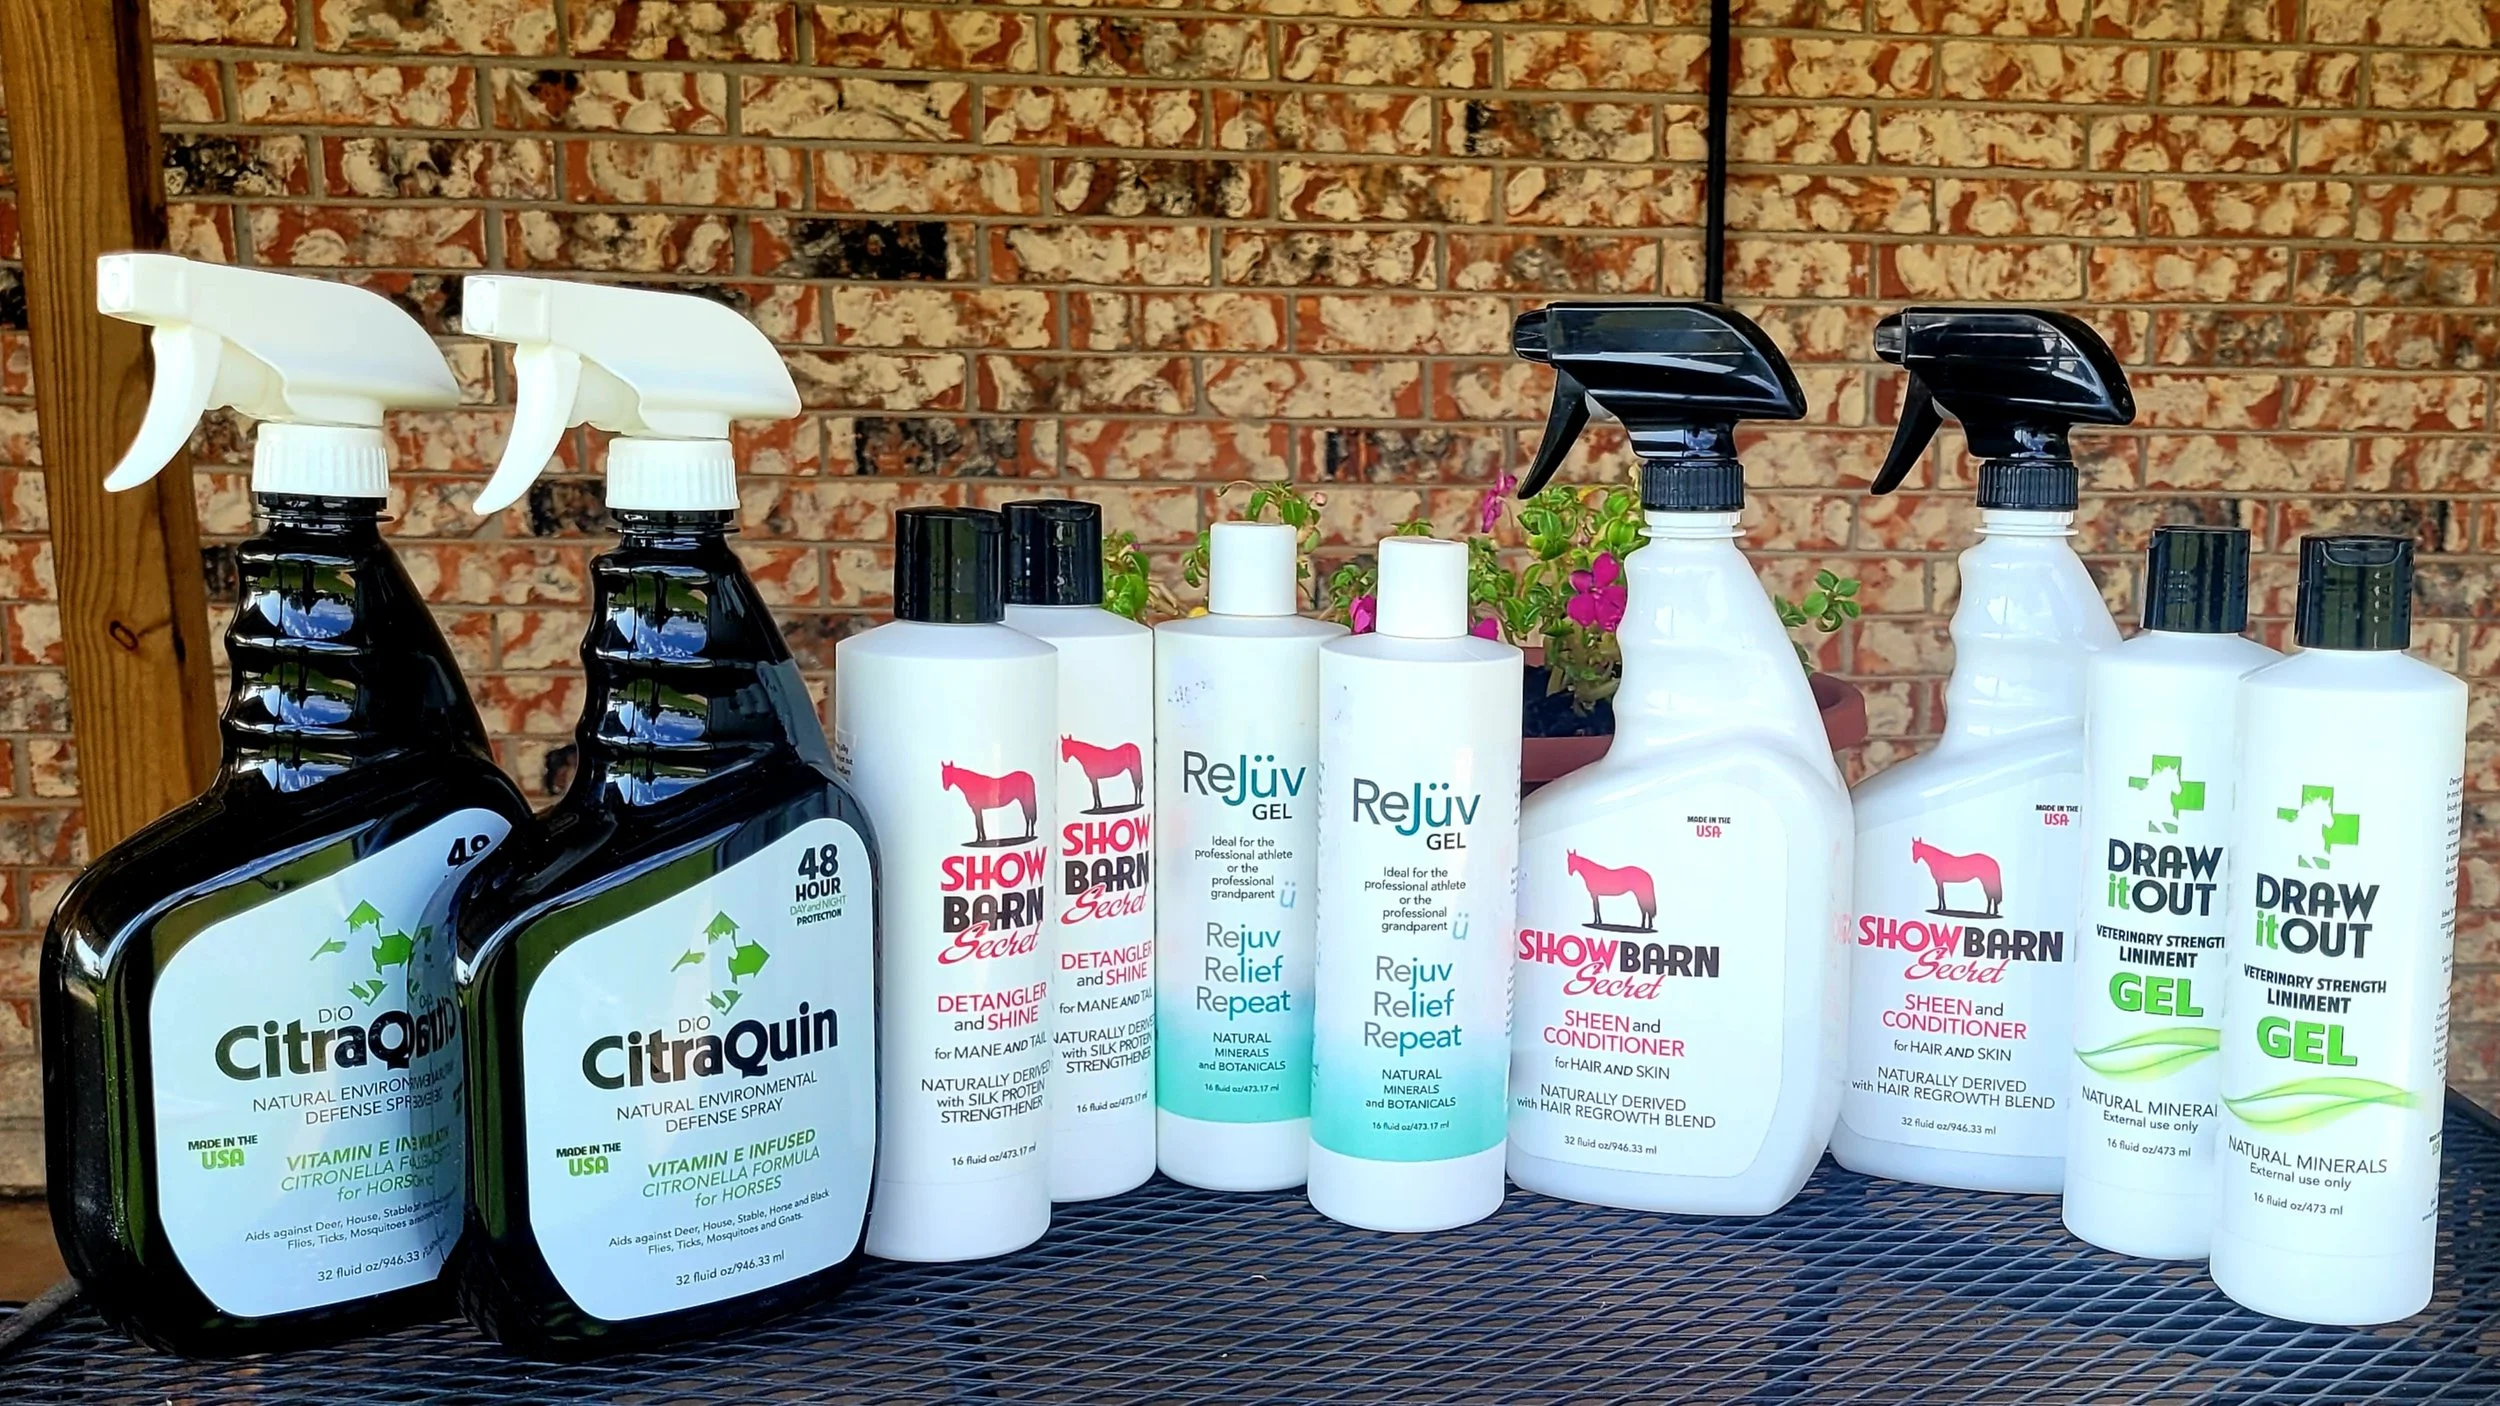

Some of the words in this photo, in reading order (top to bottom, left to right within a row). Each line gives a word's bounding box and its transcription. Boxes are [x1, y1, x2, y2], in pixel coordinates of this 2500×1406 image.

[1184, 751, 1306, 806] ReJüv
[1253, 803, 1292, 820] GEL
[1353, 778, 1481, 836] ReJüv
[2044, 813, 2070, 826] USA
[1062, 814, 1150, 856] SHOW
[1426, 833, 1466, 850] GEL
[1697, 825, 1722, 838] USA
[798, 844, 838, 880] 48
[941, 847, 1046, 891] SHOW
[1065, 851, 1148, 895] BARN
[1384, 867, 1410, 877] Ideal
[1412, 867, 1428, 878] for
[1431, 867, 1448, 877] the
[2108, 838, 2224, 882] DRAW
[796, 877, 841, 902] HOUR
[1365, 880, 1428, 891] professional
[1431, 880, 1466, 891] athlete
[1414, 894, 1432, 904] the
[2256, 872, 2380, 922] DRAW
[797, 908, 841, 926] PROTECTION
[944, 886, 1044, 933] BARN
[1061, 883, 1148, 924] Secret
[1383, 907, 1447, 920] professional
[938, 921, 1042, 964] Secret
[1207, 922, 1281, 956] Rejuv
[1382, 921, 1448, 935] grandparent
[2097, 924, 2163, 946] VETERINARY
[1062, 941, 1152, 970] DETANGLER
[1205, 955, 1284, 983] Relief
[1904, 947, 2010, 983] Secret
[2120, 946, 2198, 968] LINIMENT
[1077, 971, 1103, 987] and
[1106, 962, 1147, 985] SHINE
[1376, 956, 1453, 990] Rejuv
[1563, 962, 1665, 999] Secret
[2244, 963, 2314, 989] VETERINARY
[2316, 978, 2387, 993] STRENGTH
[938, 982, 1046, 1012] DETANGLER
[1196, 986, 1291, 1021] Repeat
[1374, 988, 1455, 1018] Relief
[1905, 994, 1972, 1016] SHEEN
[1975, 1003, 2004, 1016] and
[2109, 972, 2204, 1017] GEL
[2267, 988, 2351, 1013] LINIMENT
[319, 1006, 353, 1023] DiO
[679, 1016, 711, 1033] DiO
[955, 1015, 984, 1031] and
[988, 1005, 1038, 1030] SHINE
[1565, 1010, 1629, 1033] SHEEN
[1633, 1019, 1660, 1033] and
[1883, 1011, 2027, 1039] CONDITIONER
[215, 1010, 411, 1081] CitraQ
[582, 1001, 838, 1090] CitraQuin
[935, 1048, 952, 1059] for
[955, 1043, 1001, 1059] MANE
[1003, 1040, 1028, 1054] AND
[1030, 1032, 1047, 1047] TAIL
[1364, 1021, 1462, 1057] Repeat
[1544, 1027, 1685, 1057] CONDITIONER
[2257, 1016, 2358, 1066] GEL
[922, 1073, 1010, 1091] NATURALLY
[1013, 1060, 1051, 1084] DERIVED
[1382, 1069, 1442, 1080] NATURAL
[1555, 1056, 1569, 1069] for
[1571, 1059, 1601, 1073] HAIR
[1604, 1065, 1633, 1076] AND
[1637, 1065, 1670, 1079] SKIN
[253, 1089, 336, 1112] NATURAL
[617, 1099, 694, 1120] NATURAL
[699, 1070, 818, 1108] ENVIRONMENTAL
[937, 1097, 964, 1107] with
[969, 1092, 999, 1106] SILK
[1002, 1078, 1045, 1102] PROTEIN
[1365, 1099, 1385, 1108] and
[1387, 1097, 1456, 1109] BOTANICALS
[1384, 1085, 1440, 1095] MINERALS
[1541, 1084, 1618, 1106] NATURALLY
[1622, 1095, 1686, 1111] DERIVED
[2082, 1086, 2143, 1113] NATURAL
[306, 1105, 382, 1124] DEFENSE
[666, 1110, 737, 1132] DEFENSE
[741, 1098, 783, 1119] SPRAY
[941, 1095, 1043, 1123] STRENGTHENER
[1517, 1097, 1537, 1109] with
[1541, 1099, 1571, 1115] HAIR
[1575, 1106, 1660, 1125] REGROWTH
[1665, 1114, 1716, 1129] BLEND
[2104, 1110, 2146, 1128] External
[2150, 1121, 2170, 1130] use
[2174, 1120, 2199, 1134] only
[1383, 1122, 1400, 1130] fluid
[1401, 1122, 1438, 1131] oz/473.17
[188, 1140, 221, 1150] MADE
[224, 1138, 236, 1147] IN
[237, 1135, 258, 1145] THE
[287, 1144, 372, 1171] VITAMIN
[379, 1141, 389, 1155] E
[556, 1147, 587, 1158] MADE
[589, 1145, 600, 1154] IN
[602, 1142, 621, 1153] THE
[648, 1150, 728, 1178] VITAMIN
[734, 1147, 744, 1162] E
[749, 1129, 816, 1160] INFUSED
[1564, 1136, 1575, 1145] 32
[1577, 1137, 1595, 1148] fluid
[1598, 1140, 1643, 1153] oz/946.33
[1646, 1146, 1657, 1155] ml
[2229, 1134, 2292, 1166] NATURAL
[2297, 1155, 2387, 1173] MINERALS
[202, 1149, 244, 1170] USA
[569, 1156, 609, 1176] USA
[642, 1166, 748, 1198] CITRONELLA
[752, 1146, 820, 1176] FORMULA
[281, 1160, 394, 1191] CITRONELLA
[2250, 1162, 2295, 1182] External
[2299, 1176, 2320, 1186] use
[2324, 1178, 2351, 1191] only
[695, 1193, 717, 1208] for
[722, 1176, 782, 1202] HORSES
[2254, 1192, 2264, 1202] 16
[2267, 1195, 2287, 1208] fluid
[2290, 1202, 2326, 1214] oz/473
[2330, 1205, 2343, 1215] ml
[609, 1236, 632, 1248] Aids
[636, 1230, 671, 1244] against
[674, 1226, 700, 1237] Deer,
[703, 1218, 735, 1232] House,
[738, 1208, 767, 1224] Stable,
[770, 1200, 792, 1214] Horse
[794, 1194, 809, 1207] and
[811, 1188, 830, 1201] Black
[648, 1244, 674, 1255] Flies,
[678, 1238, 704, 1250] Ticks,
[706, 1226, 758, 1244] Mosquitoes
[761, 1219, 776, 1230] and
[778, 1212, 804, 1225] Gnats.
[676, 1274, 690, 1286] 32
[693, 1268, 717, 1282] fluid
[720, 1255, 770, 1277] oz/946.33
[773, 1251, 784, 1264] ml
